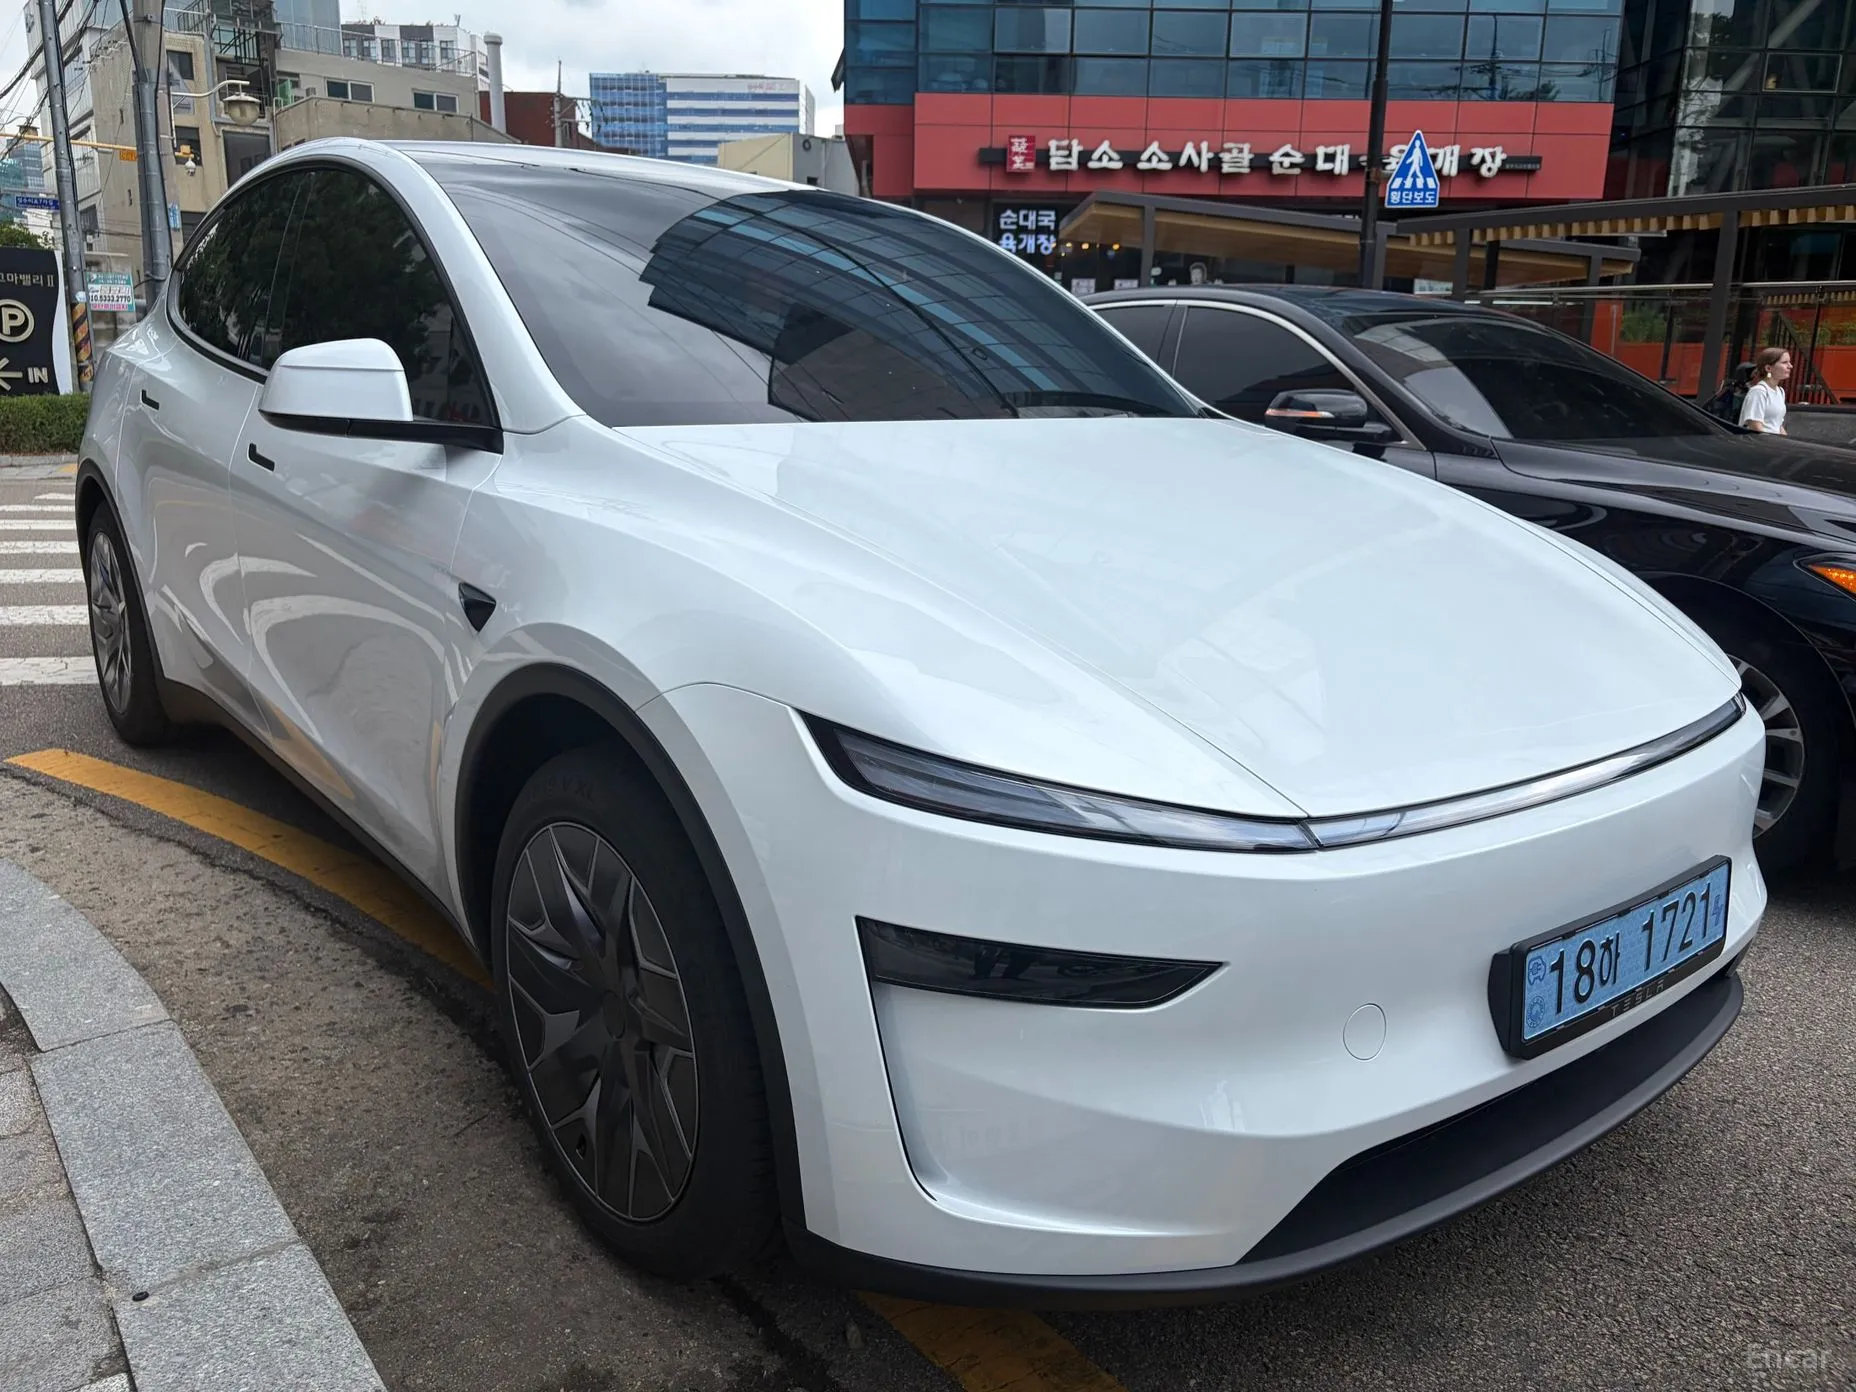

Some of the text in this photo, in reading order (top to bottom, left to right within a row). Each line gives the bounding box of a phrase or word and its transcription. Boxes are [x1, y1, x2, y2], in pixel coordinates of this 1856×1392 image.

[1048, 138, 1124, 171] 담소
[1136, 140, 1255, 174] 소사골
[1390, 191, 1436, 204] 횡단보도
[999, 209, 1057, 230] 순대국
[999, 232, 1057, 256] 육개장
[1, 306, 26, 335] P
[27, 367, 48, 383] IN
[1549, 881, 1711, 1016] 18하 1721
[1610, 979, 1665, 1017] TESLA
